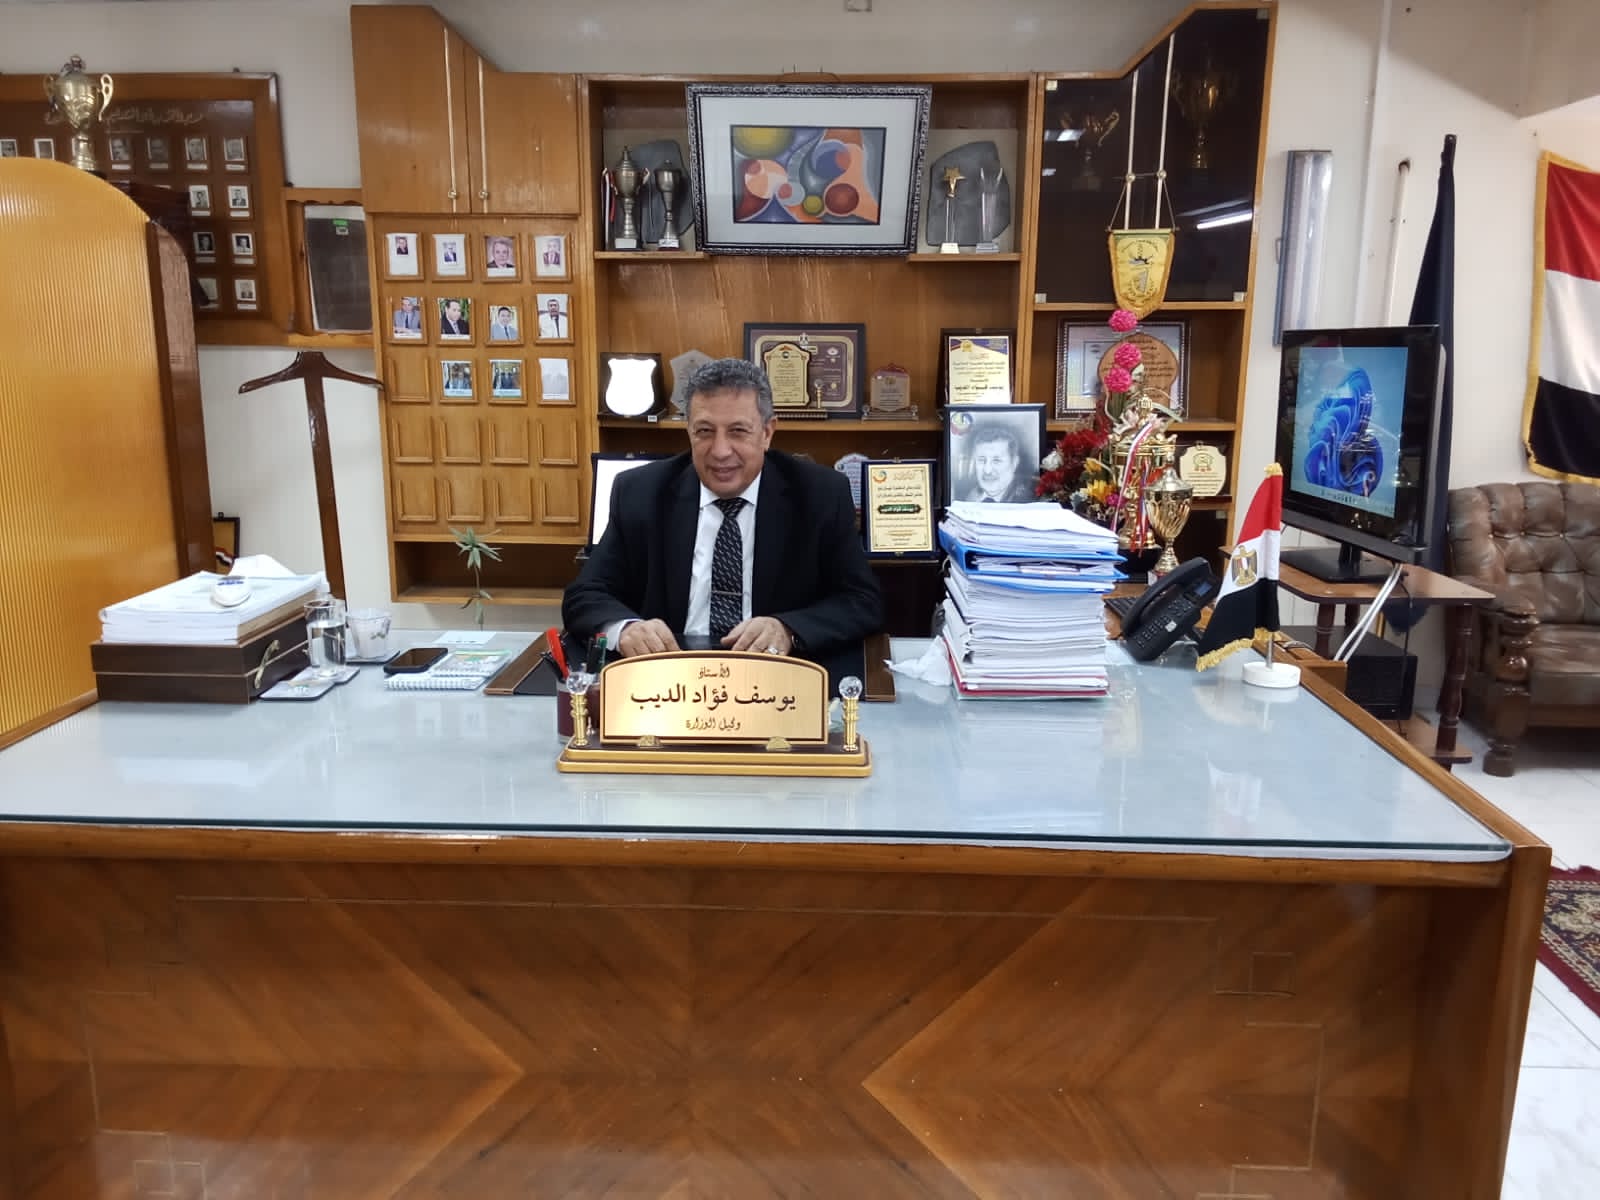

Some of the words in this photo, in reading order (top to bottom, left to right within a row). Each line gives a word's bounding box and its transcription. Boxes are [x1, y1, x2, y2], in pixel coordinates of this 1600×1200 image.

[630, 682, 687, 710] الديب
[691, 684, 729, 711] فؤاد
[733, 685, 797, 712] يوسف
[685, 716, 717, 731] الوزارة
[718, 716, 741, 731] وكيل
